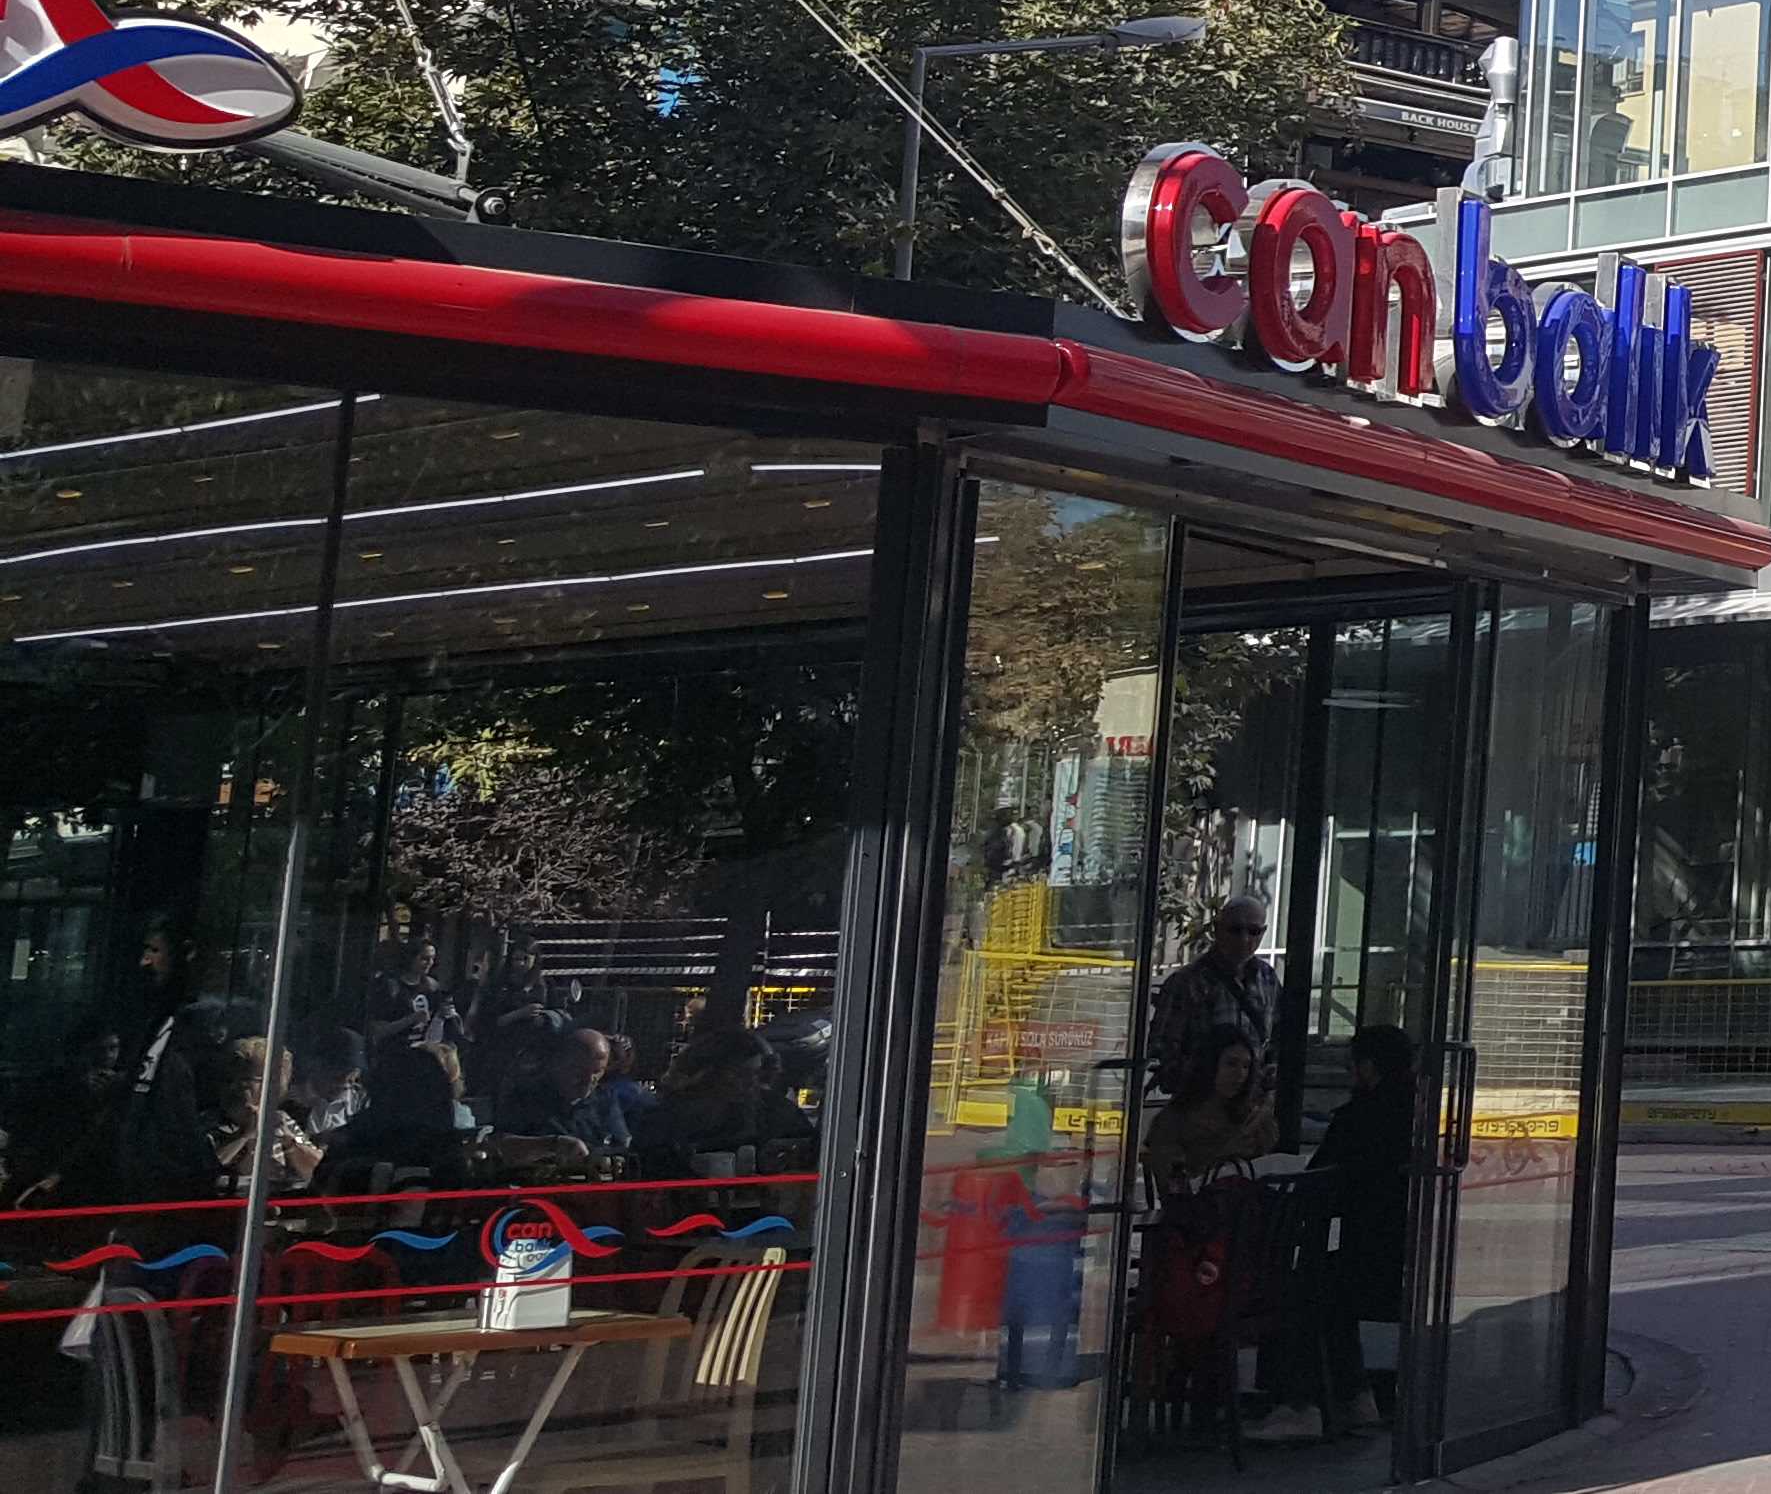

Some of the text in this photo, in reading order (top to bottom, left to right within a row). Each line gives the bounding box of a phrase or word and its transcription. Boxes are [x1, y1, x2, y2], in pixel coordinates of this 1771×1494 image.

[1401, 110, 1478, 134] BACK HOUSE
[1130, 146, 1440, 403] can
[507, 1221, 553, 1240] can
